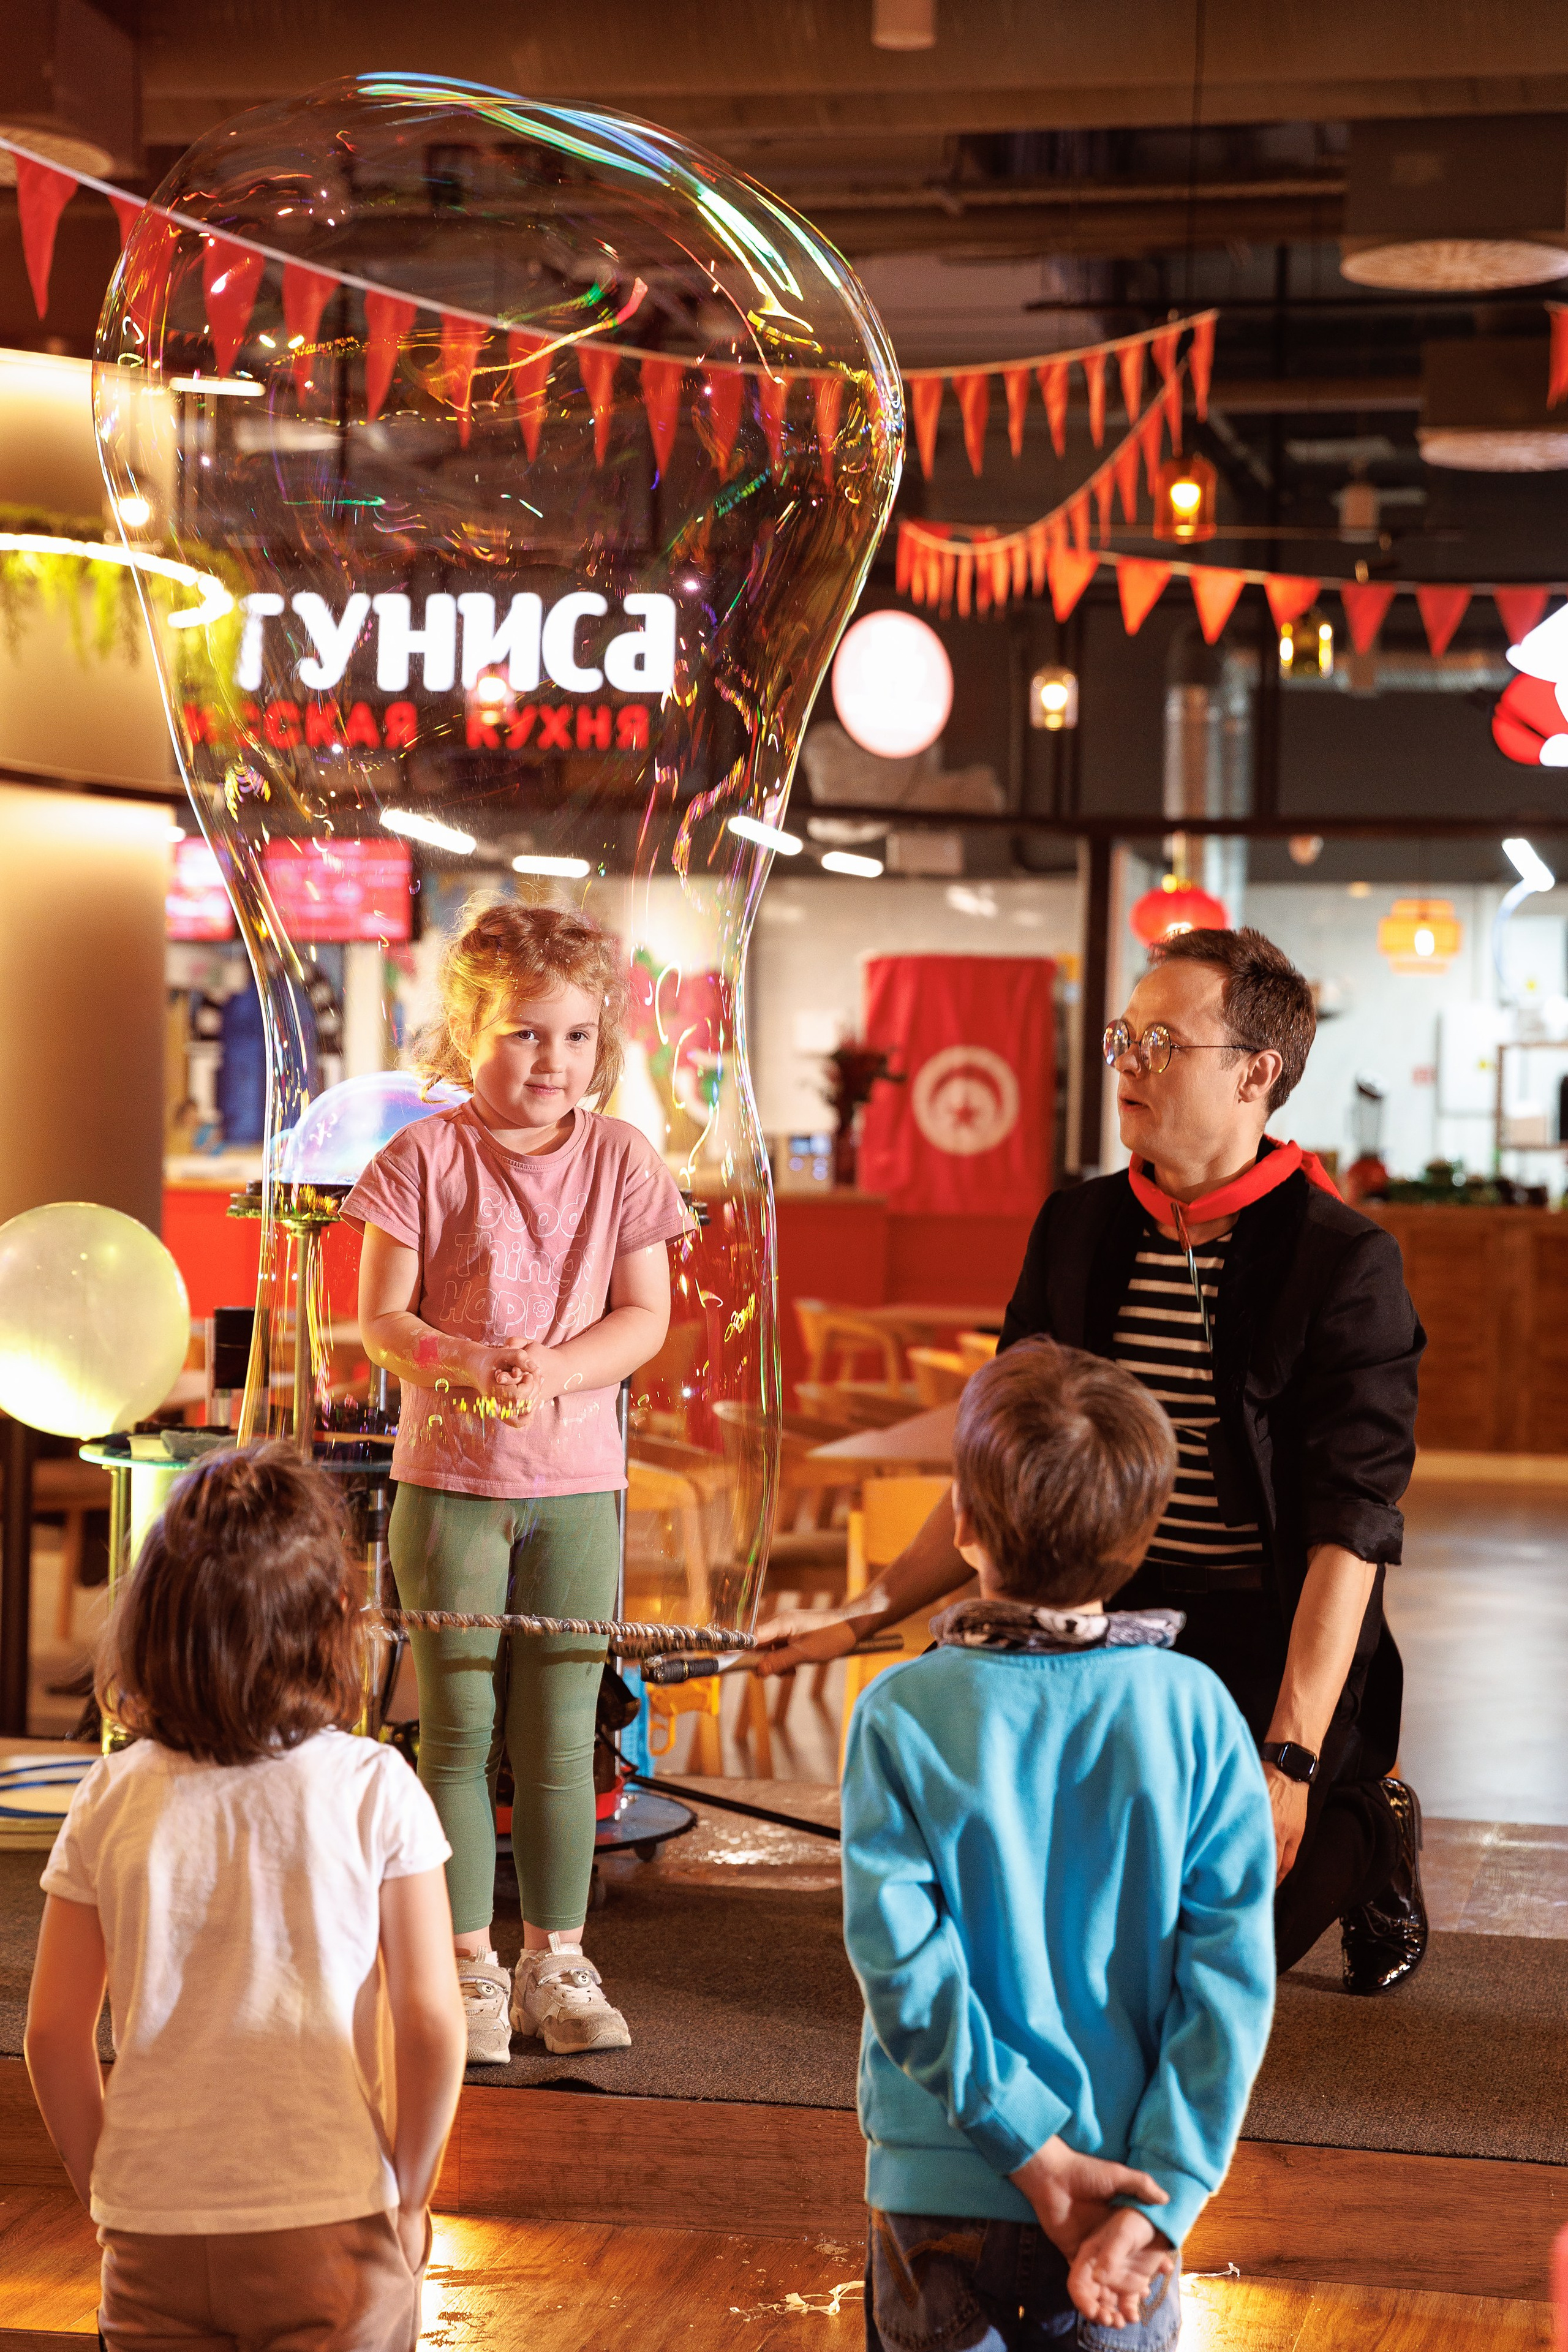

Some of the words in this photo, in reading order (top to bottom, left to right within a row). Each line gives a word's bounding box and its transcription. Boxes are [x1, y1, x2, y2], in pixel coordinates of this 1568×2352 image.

[466, 704, 650, 751] КУХНЯ
[473, 1186, 588, 1238] Good
[455, 1231, 597, 1298] Things
[439, 1280, 594, 1340] Happen
